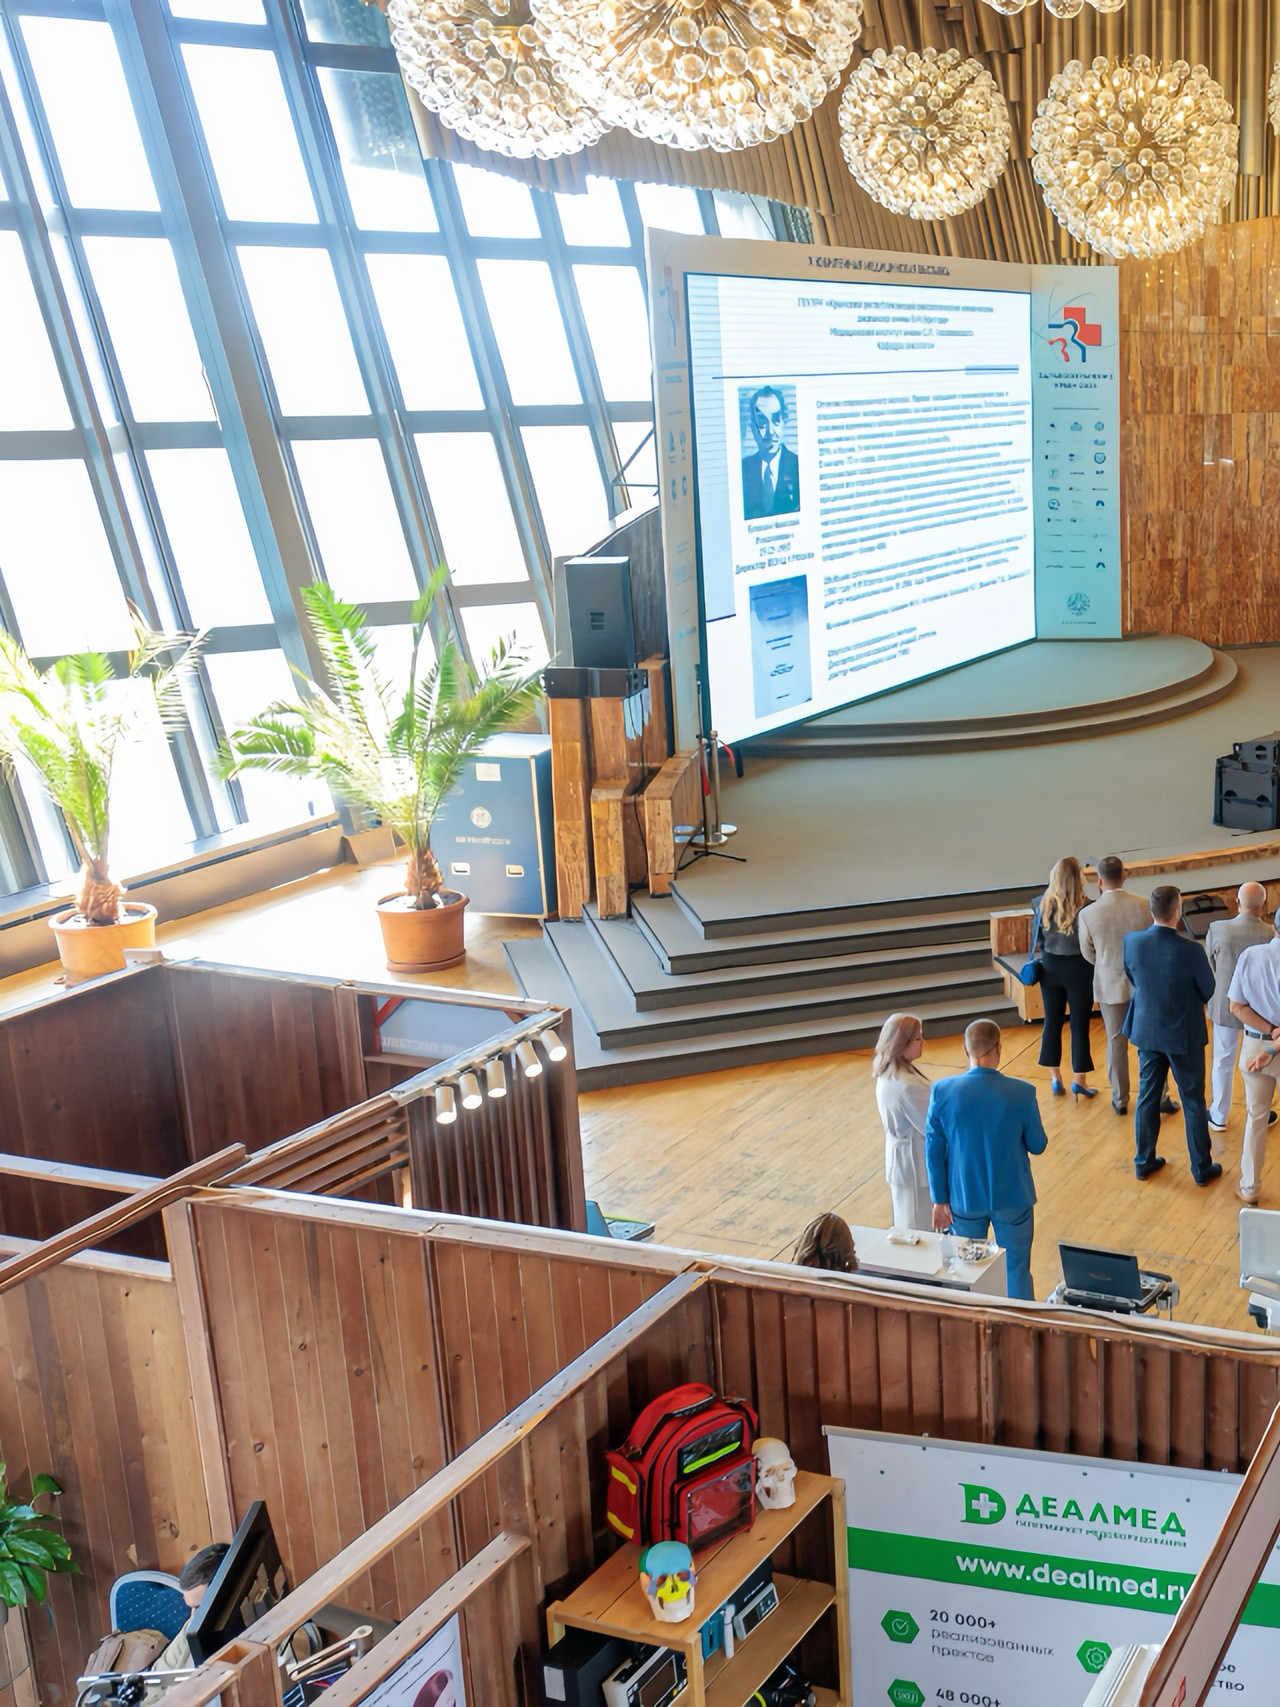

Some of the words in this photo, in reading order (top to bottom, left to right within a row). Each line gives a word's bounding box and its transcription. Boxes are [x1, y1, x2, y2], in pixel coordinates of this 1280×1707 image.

[1015, 1493, 1187, 1538] ДЕАЛМЕД
[930, 1609, 949, 1623] 20
[955, 1613, 996, 1629] 000+
[936, 1687, 954, 1702] 48
